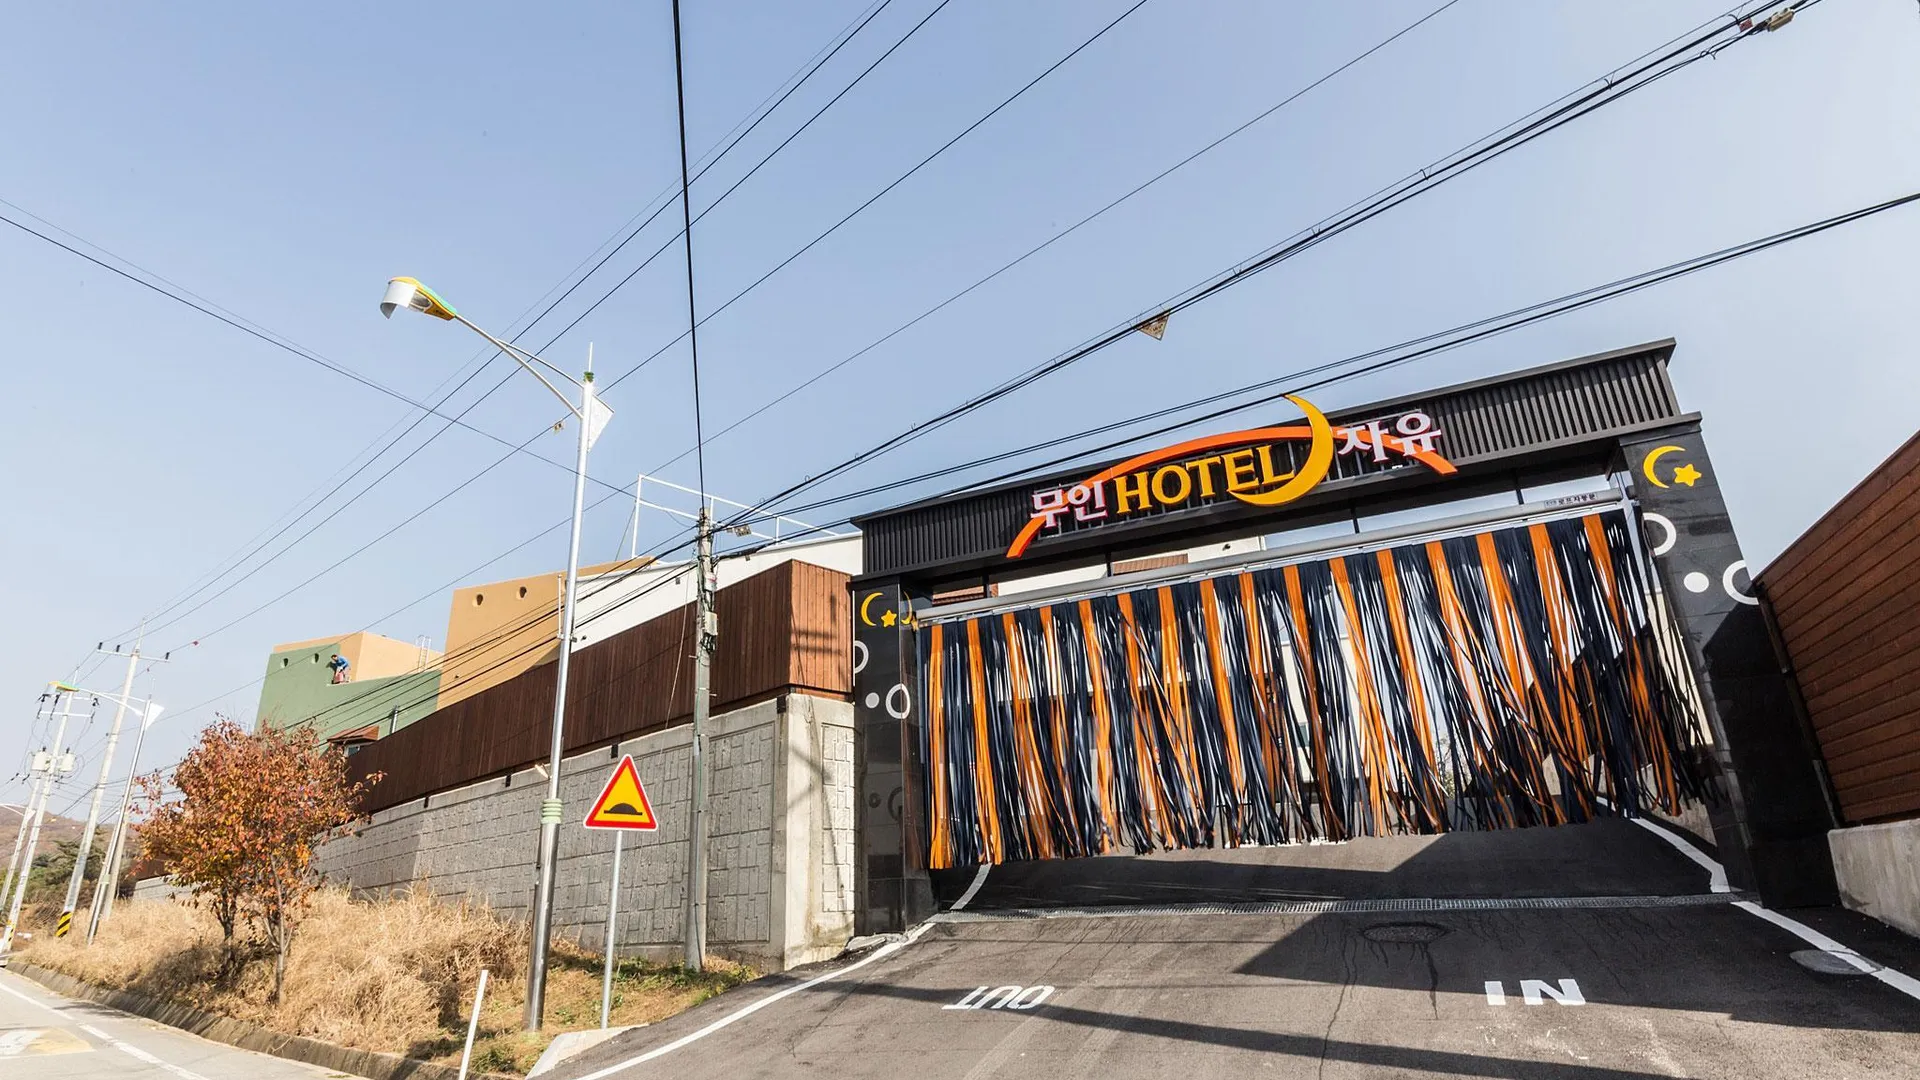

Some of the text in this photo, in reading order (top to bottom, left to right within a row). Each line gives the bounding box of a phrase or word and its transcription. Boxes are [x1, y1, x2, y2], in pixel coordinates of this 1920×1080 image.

[1030, 412, 1442, 528] 무인 HOTEL 자유
[941, 984, 1056, 1010] OUT
[1484, 978, 1587, 1006] IN
